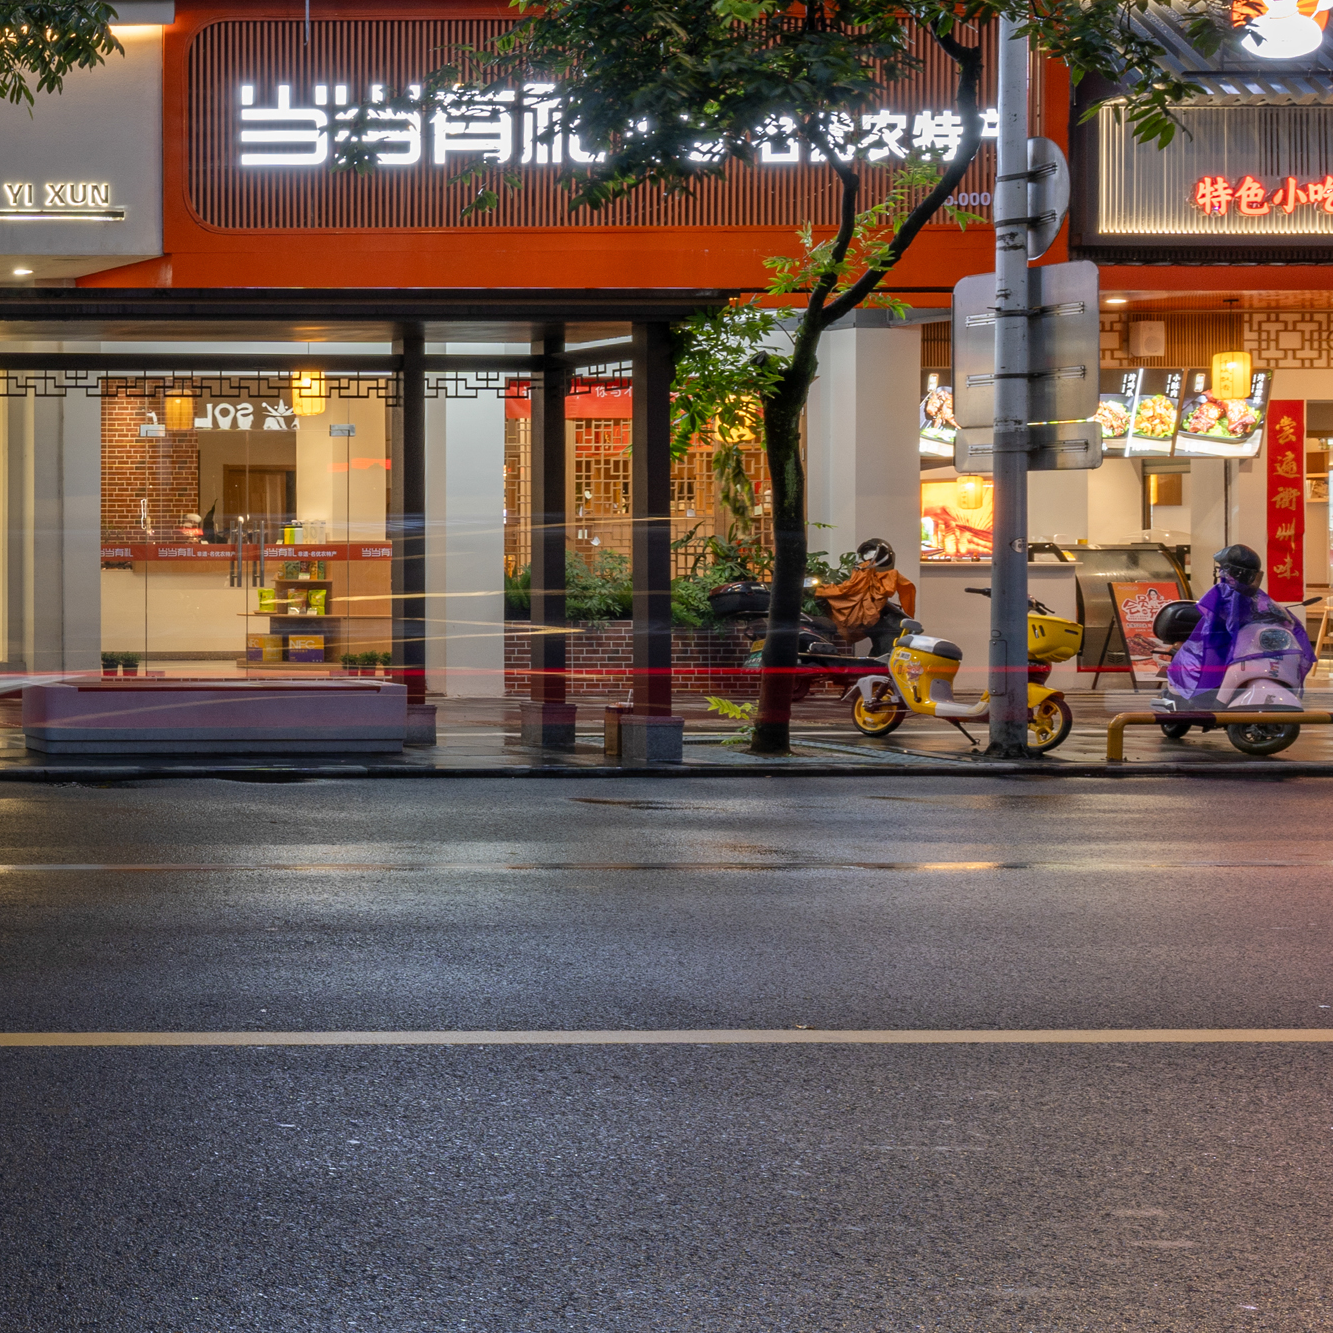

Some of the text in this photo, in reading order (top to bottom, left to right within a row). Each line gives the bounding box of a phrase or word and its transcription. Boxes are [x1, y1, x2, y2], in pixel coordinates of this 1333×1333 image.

[4, 183, 110, 207] YI XUN
[289, 640, 315, 649] NFC
